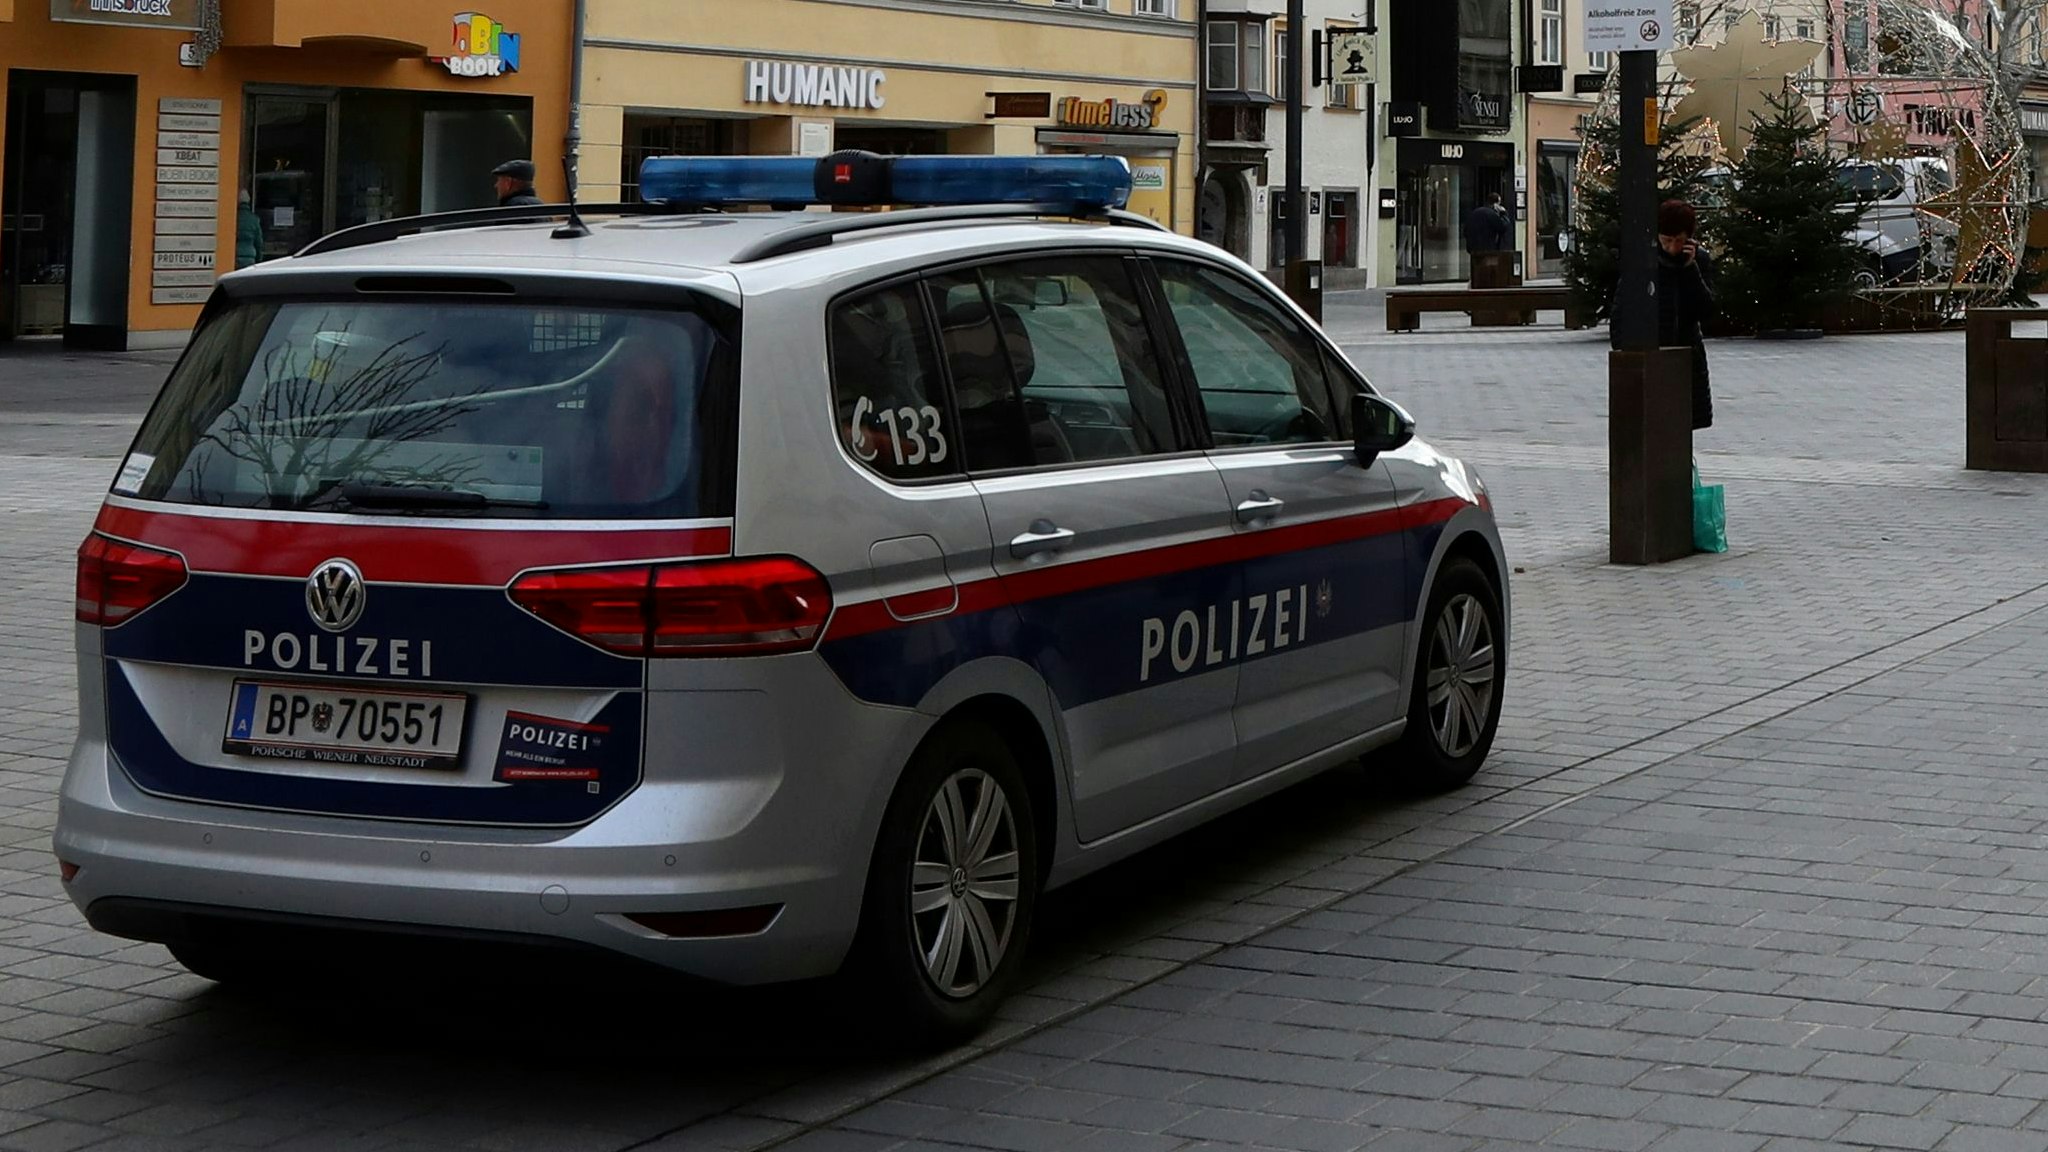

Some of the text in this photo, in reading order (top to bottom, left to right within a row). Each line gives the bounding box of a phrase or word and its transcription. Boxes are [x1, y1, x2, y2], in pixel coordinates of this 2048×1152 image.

[1588, 9, 1635, 17] Alkoholfreie
[450, 56, 501, 76] BOOK
[744, 60, 886, 109] HUMANIC
[175, 150, 201, 160] XBEAT
[189, 169, 217, 181] BOOK
[157, 253, 196, 263] PROTEUS
[878, 405, 948, 465] 133
[1139, 583, 1308, 682] POLIZEI
[243, 629, 432, 677] POLIZEI
[237, 719, 247, 732] A
[265, 693, 444, 747] BP 70551
[509, 723, 588, 751] POLIZEI
[251, 745, 427, 768] PORSCHE WIENER NEUSTADT
[505, 750, 522, 758] MEHR
